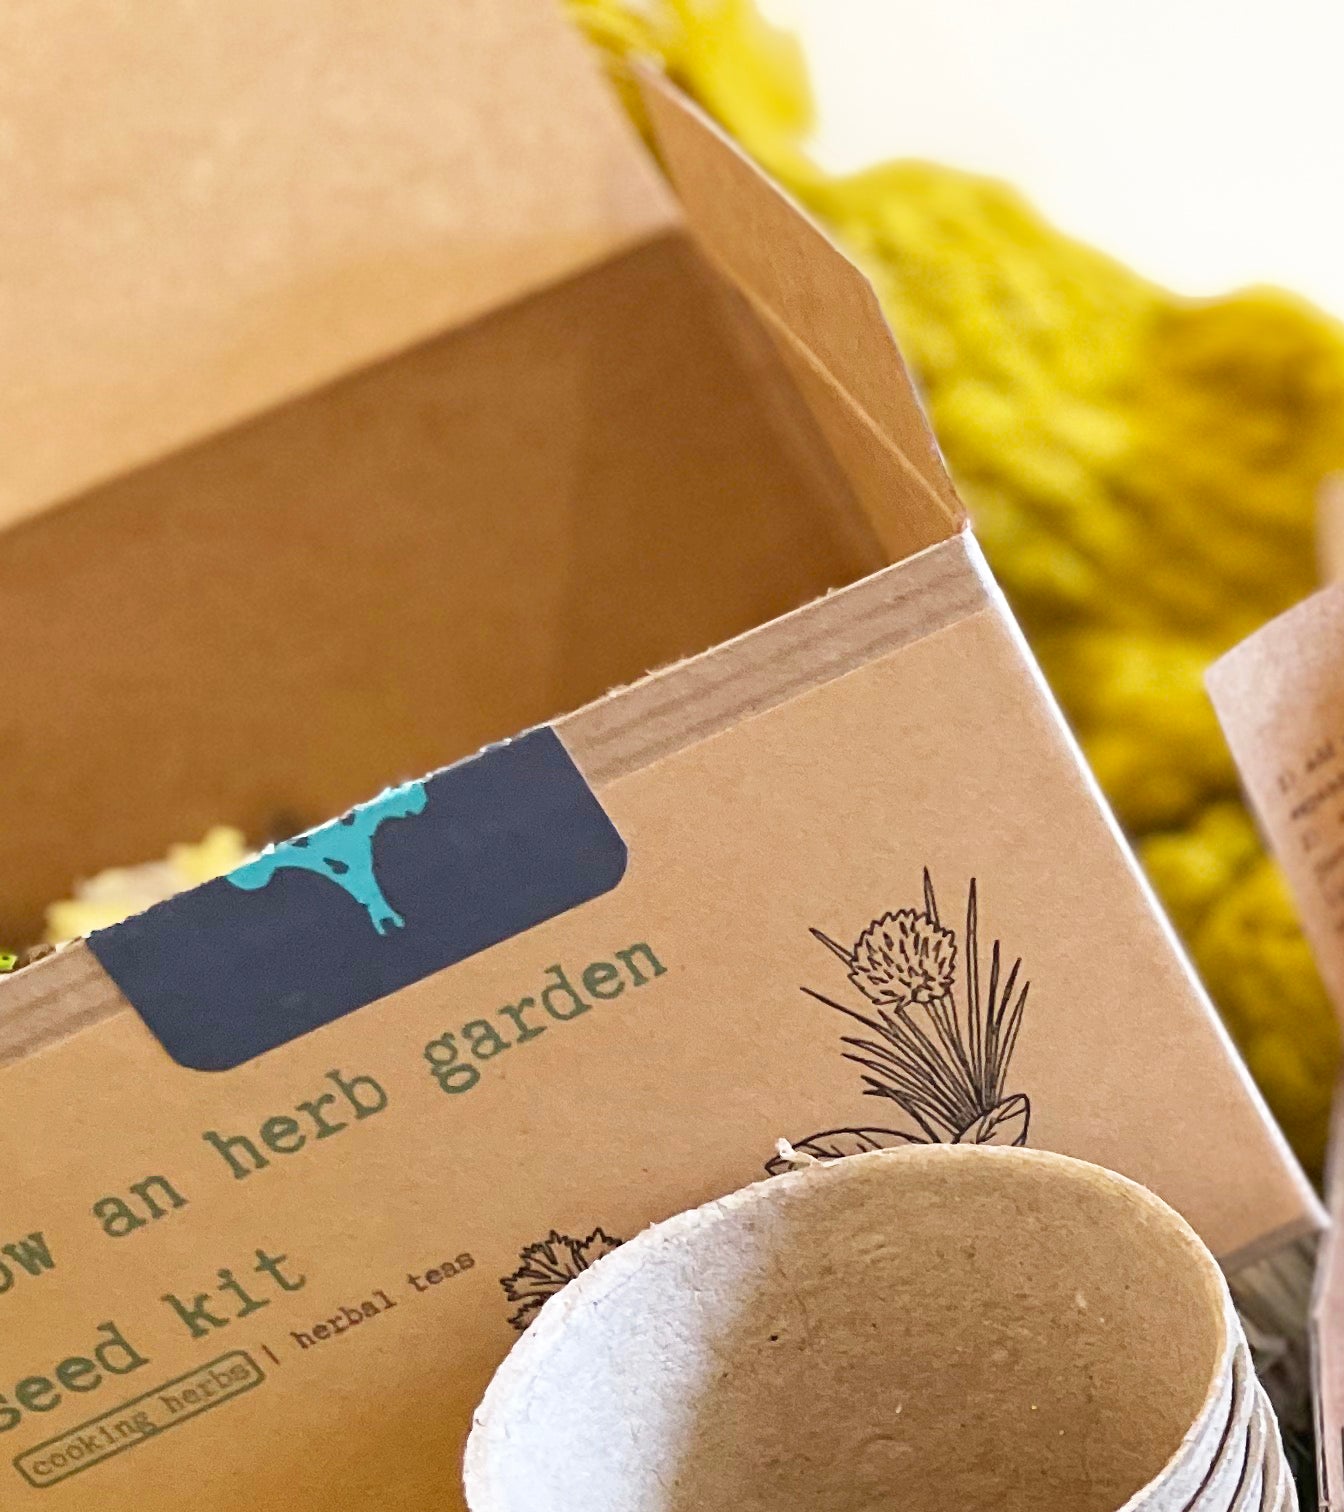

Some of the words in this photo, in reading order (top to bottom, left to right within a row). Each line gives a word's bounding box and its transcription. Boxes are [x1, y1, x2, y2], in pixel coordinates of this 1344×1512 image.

[91, 1175, 190, 1238] an
[202, 1070, 388, 1181] herb
[423, 941, 667, 1095] garden
[32, 1409, 161, 1476] cooking
[158, 1362, 250, 1415] herbs
[290, 1291, 398, 1351] herbal
[406, 1248, 476, 1295] teas
[161, 1248, 307, 1339] kit
